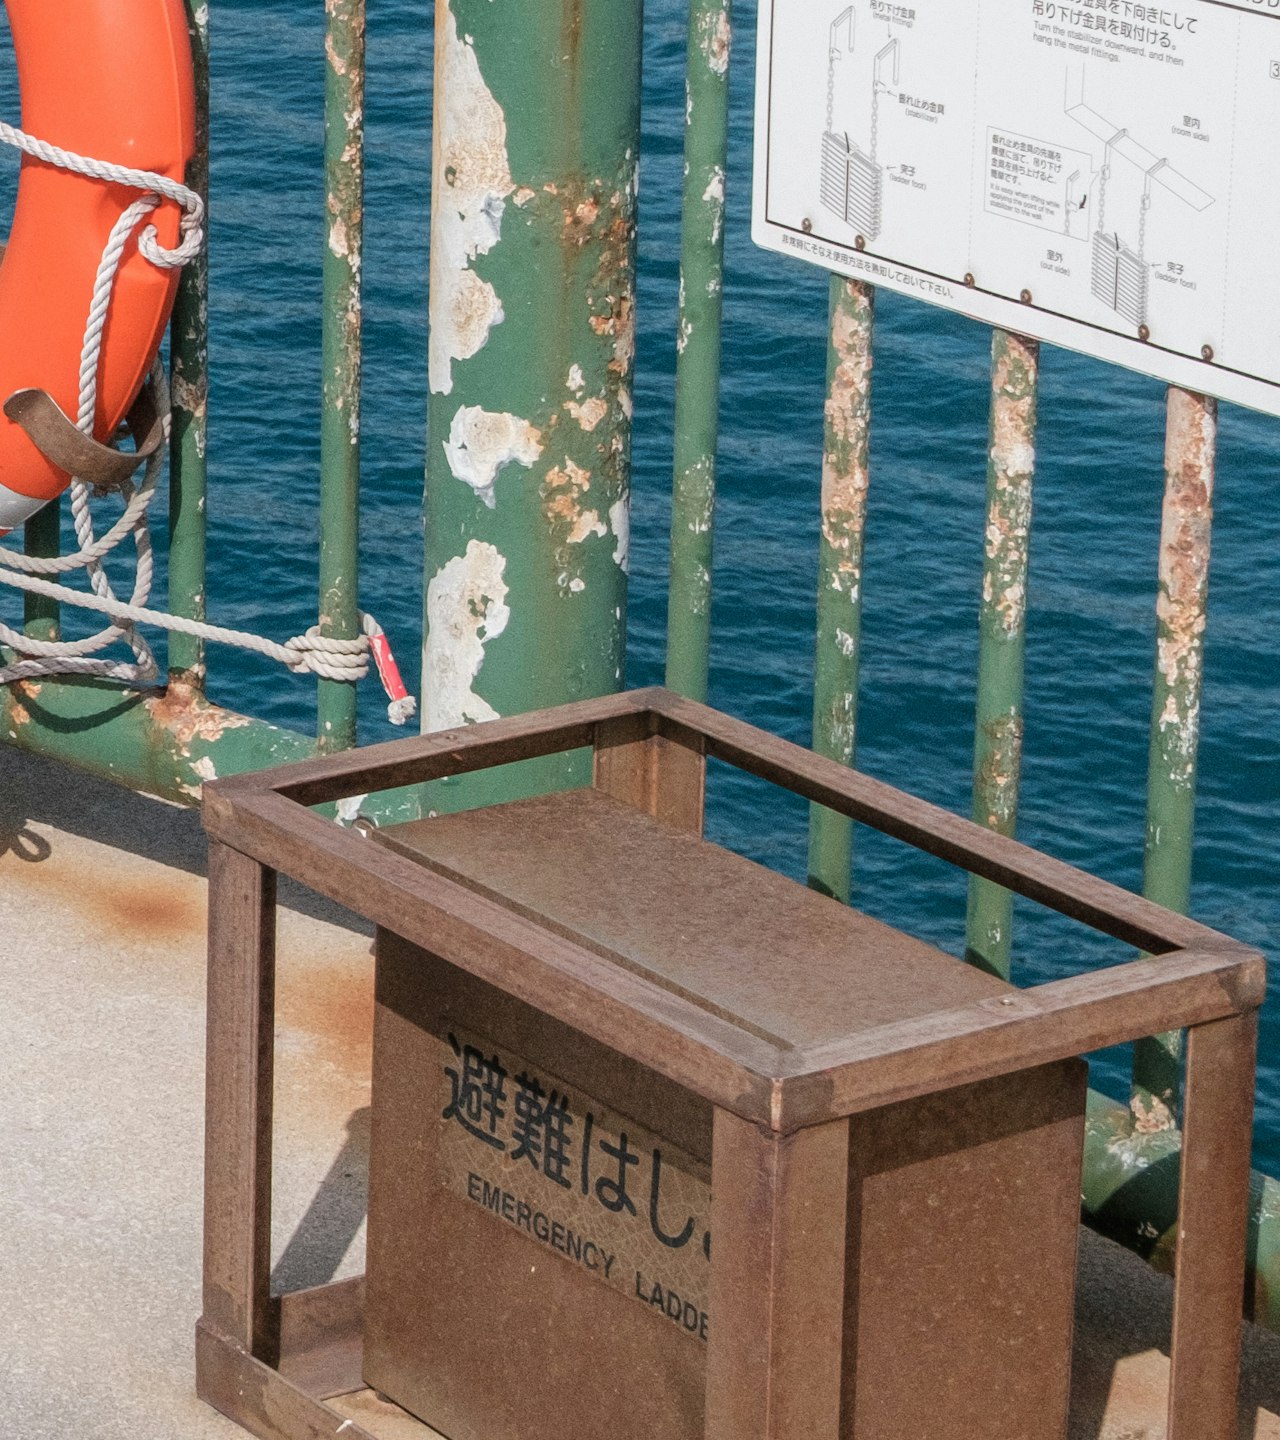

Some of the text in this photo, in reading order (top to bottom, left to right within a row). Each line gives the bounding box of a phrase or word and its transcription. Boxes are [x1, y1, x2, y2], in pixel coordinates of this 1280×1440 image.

[1032, 0, 1177, 51] 吊り下げ金具を取付ける。
[1032, 32, 1053, 47] hang
[1053, 36, 1067, 48] the
[1068, 40, 1089, 54] metal
[1034, 20, 1051, 32] Turn
[1052, 24, 1065, 36] the
[1067, 27, 1102, 45] stabilizer
[1148, 49, 1164, 62] and
[1165, 53, 1184, 66] then
[442, 1032, 711, 1262] 避難はし
[467, 1171, 615, 1278] EMERGENCY
